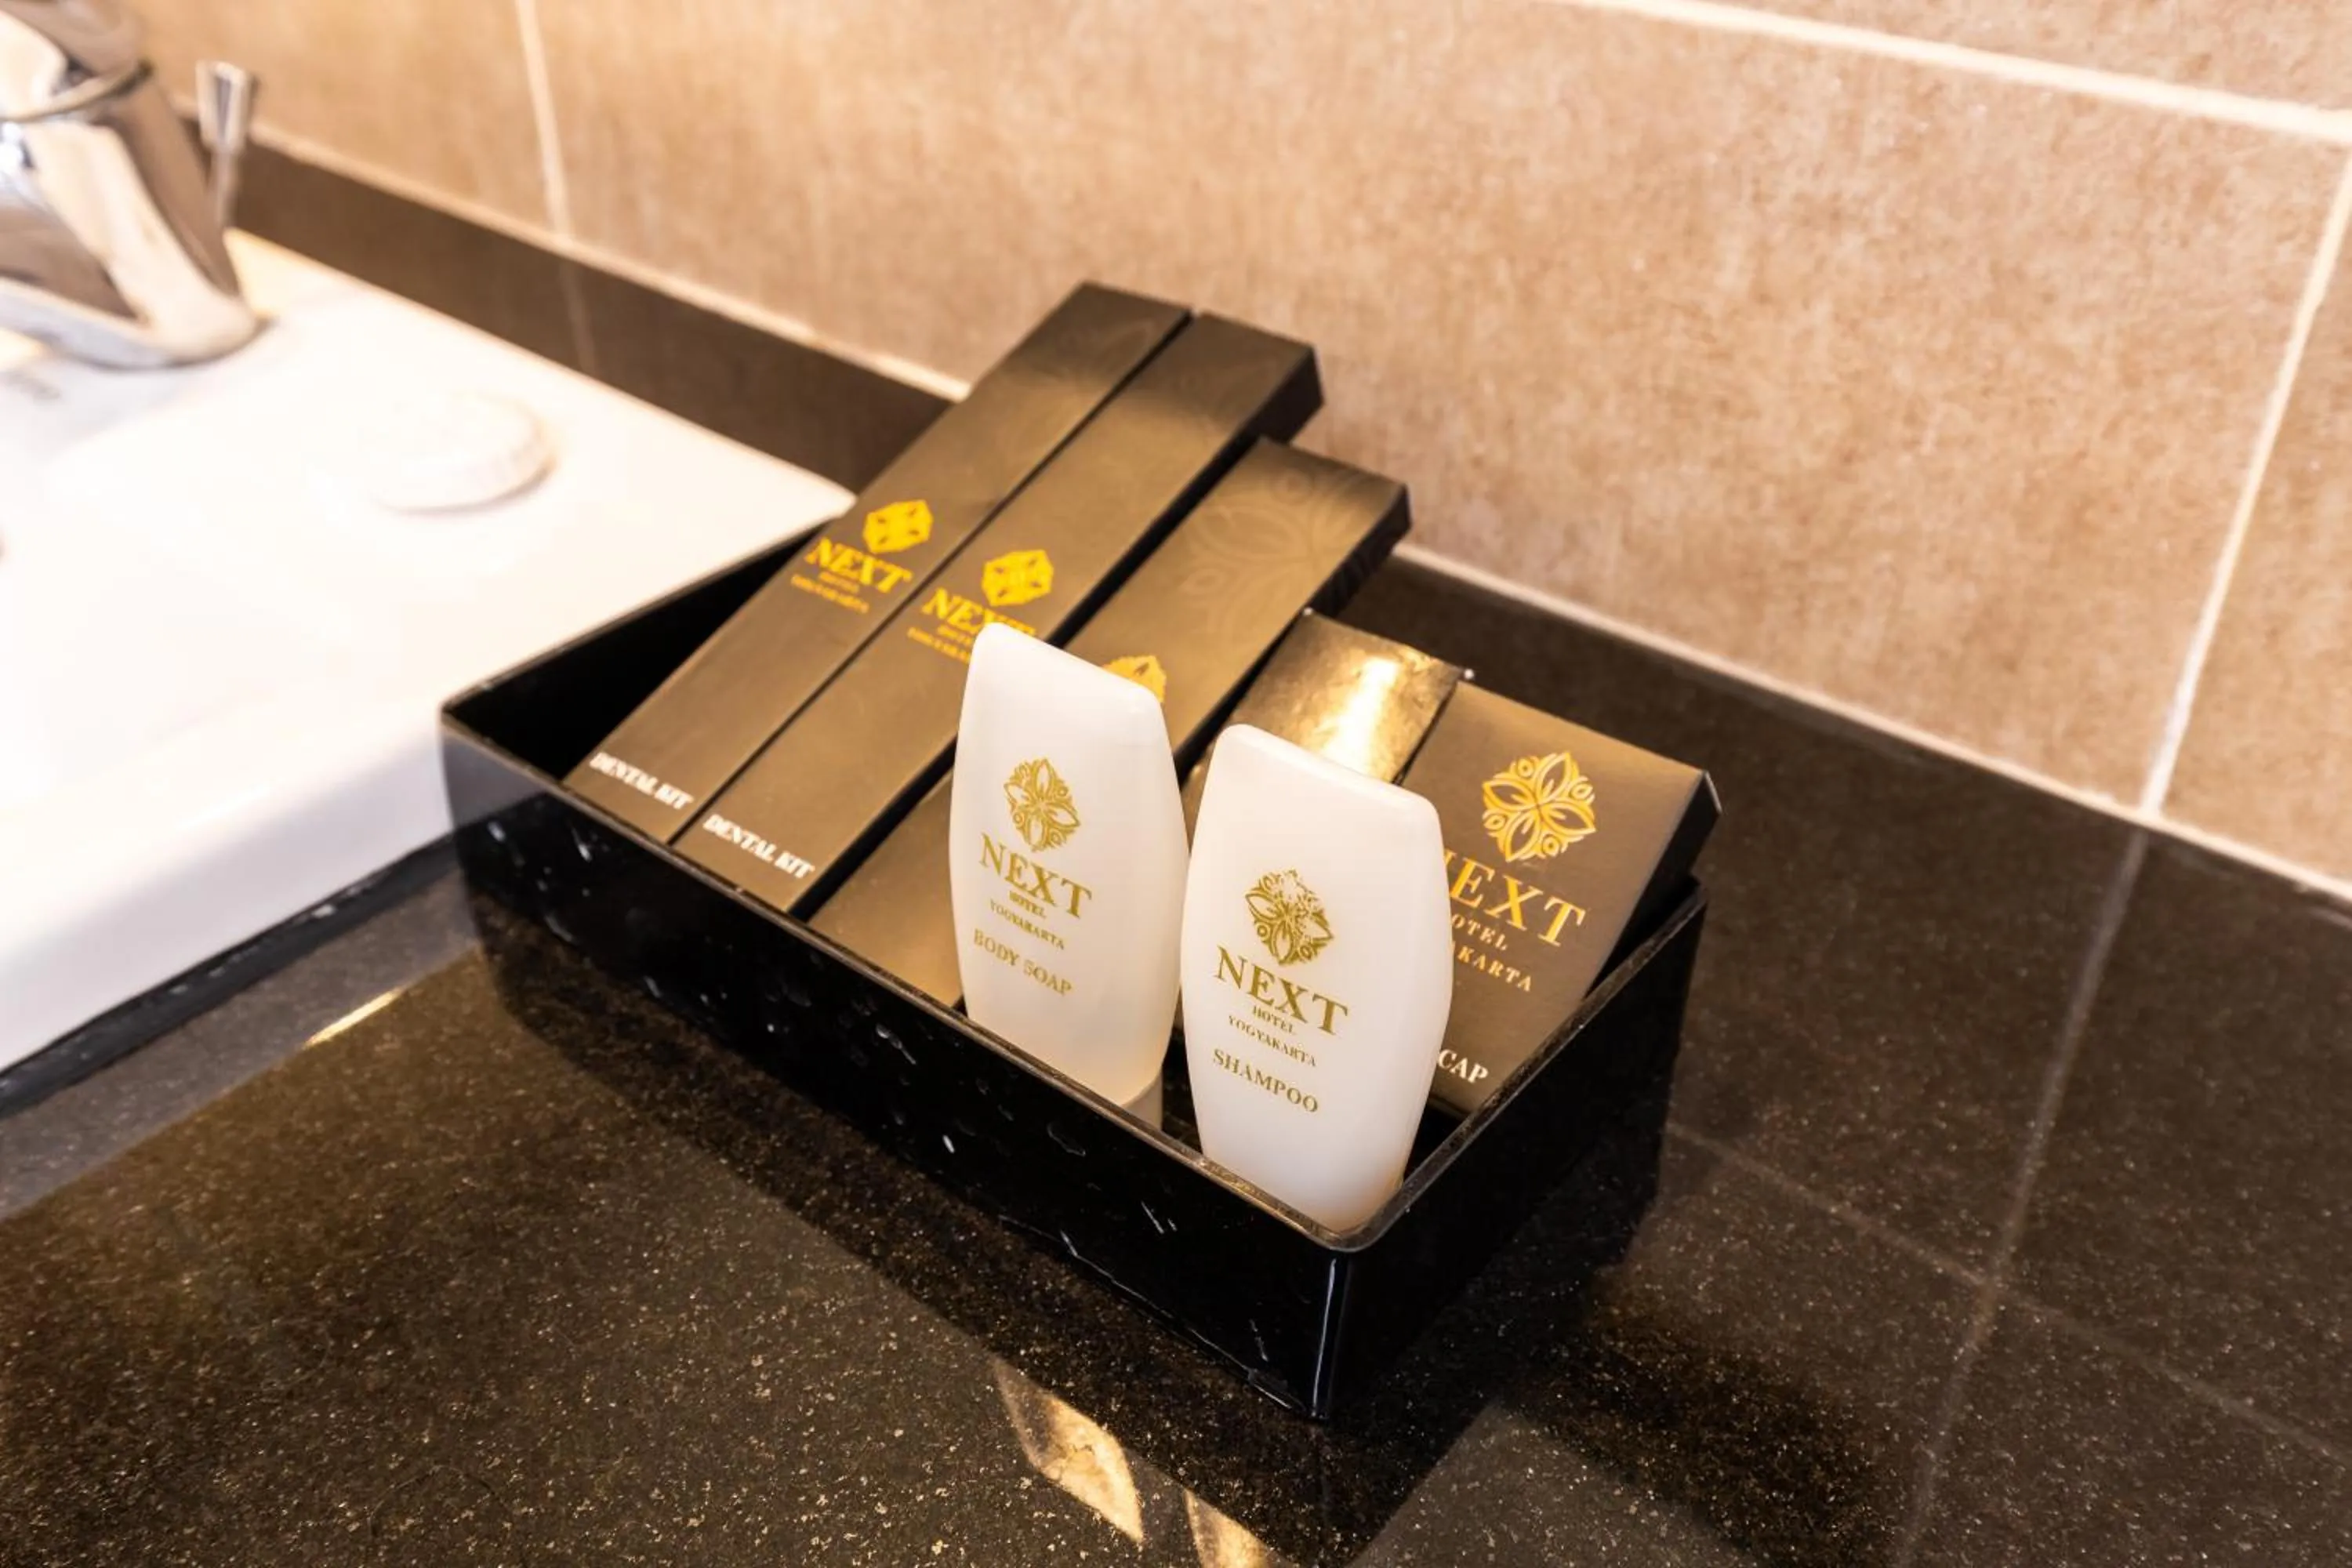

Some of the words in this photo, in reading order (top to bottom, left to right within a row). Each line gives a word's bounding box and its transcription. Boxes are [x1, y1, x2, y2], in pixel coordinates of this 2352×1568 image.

[804, 536, 913, 593] NEXT
[921, 587, 1036, 637] NE
[702, 814, 778, 863] DENTAL
[978, 832, 1093, 919] NEXT
[989, 898, 1065, 950] YOGYAKARTA
[1008, 890, 1047, 919] HOTEL
[1451, 913, 1509, 951] OTEL
[973, 927, 1020, 967] BODY
[1023, 958, 1073, 996] SOAP
[1214, 944, 1349, 1036] NEXT
[1228, 1015, 1316, 1067] YOGYAKARTA
[1251, 1004, 1296, 1035] HOTEL
[1213, 1048, 1319, 1113] SHAMPOO
[1438, 1049, 1489, 1083] CAP
